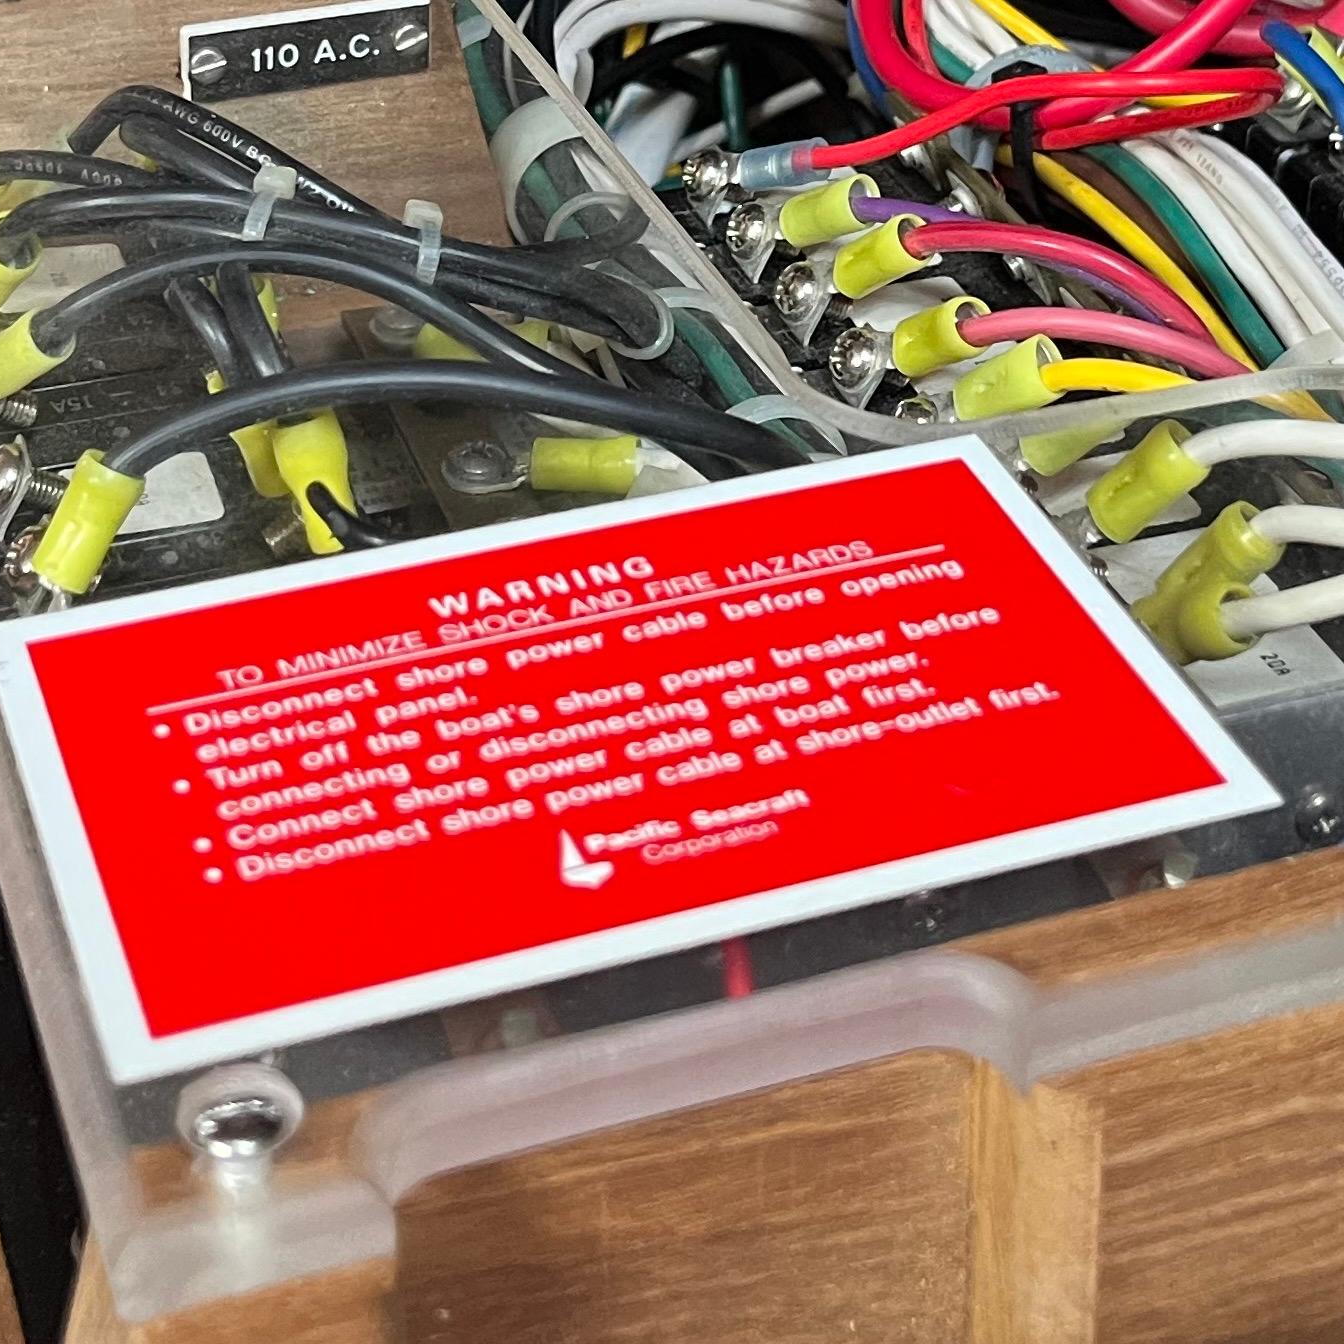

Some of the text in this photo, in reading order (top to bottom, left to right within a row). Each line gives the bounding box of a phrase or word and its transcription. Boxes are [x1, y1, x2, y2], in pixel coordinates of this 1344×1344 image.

[251, 32, 380, 72] 110 A.C.
[202, 119, 245, 150] 600V
[47, 394, 93, 415] 15A
[216, 540, 874, 691] TO MINIMIZE SHOCK AND FIRE HAZARDS
[428, 555, 654, 618] WARNING
[183, 557, 964, 735] Disconnect shore power cable before opening
[1258, 649, 1290, 677] 20A
[195, 686, 479, 763] electrical panel.
[205, 601, 1000, 790] Turn off the boat's shore power breaker before
[216, 651, 930, 821] connecting or disconnecting shore power.
[226, 676, 937, 850] Connect shore power cable at boat first.
[235, 680, 1061, 882] Disconnect shore power cable at shore-outlet first.
[583, 787, 811, 855] Pacific Seacraft
[641, 818, 780, 865] Corporation
